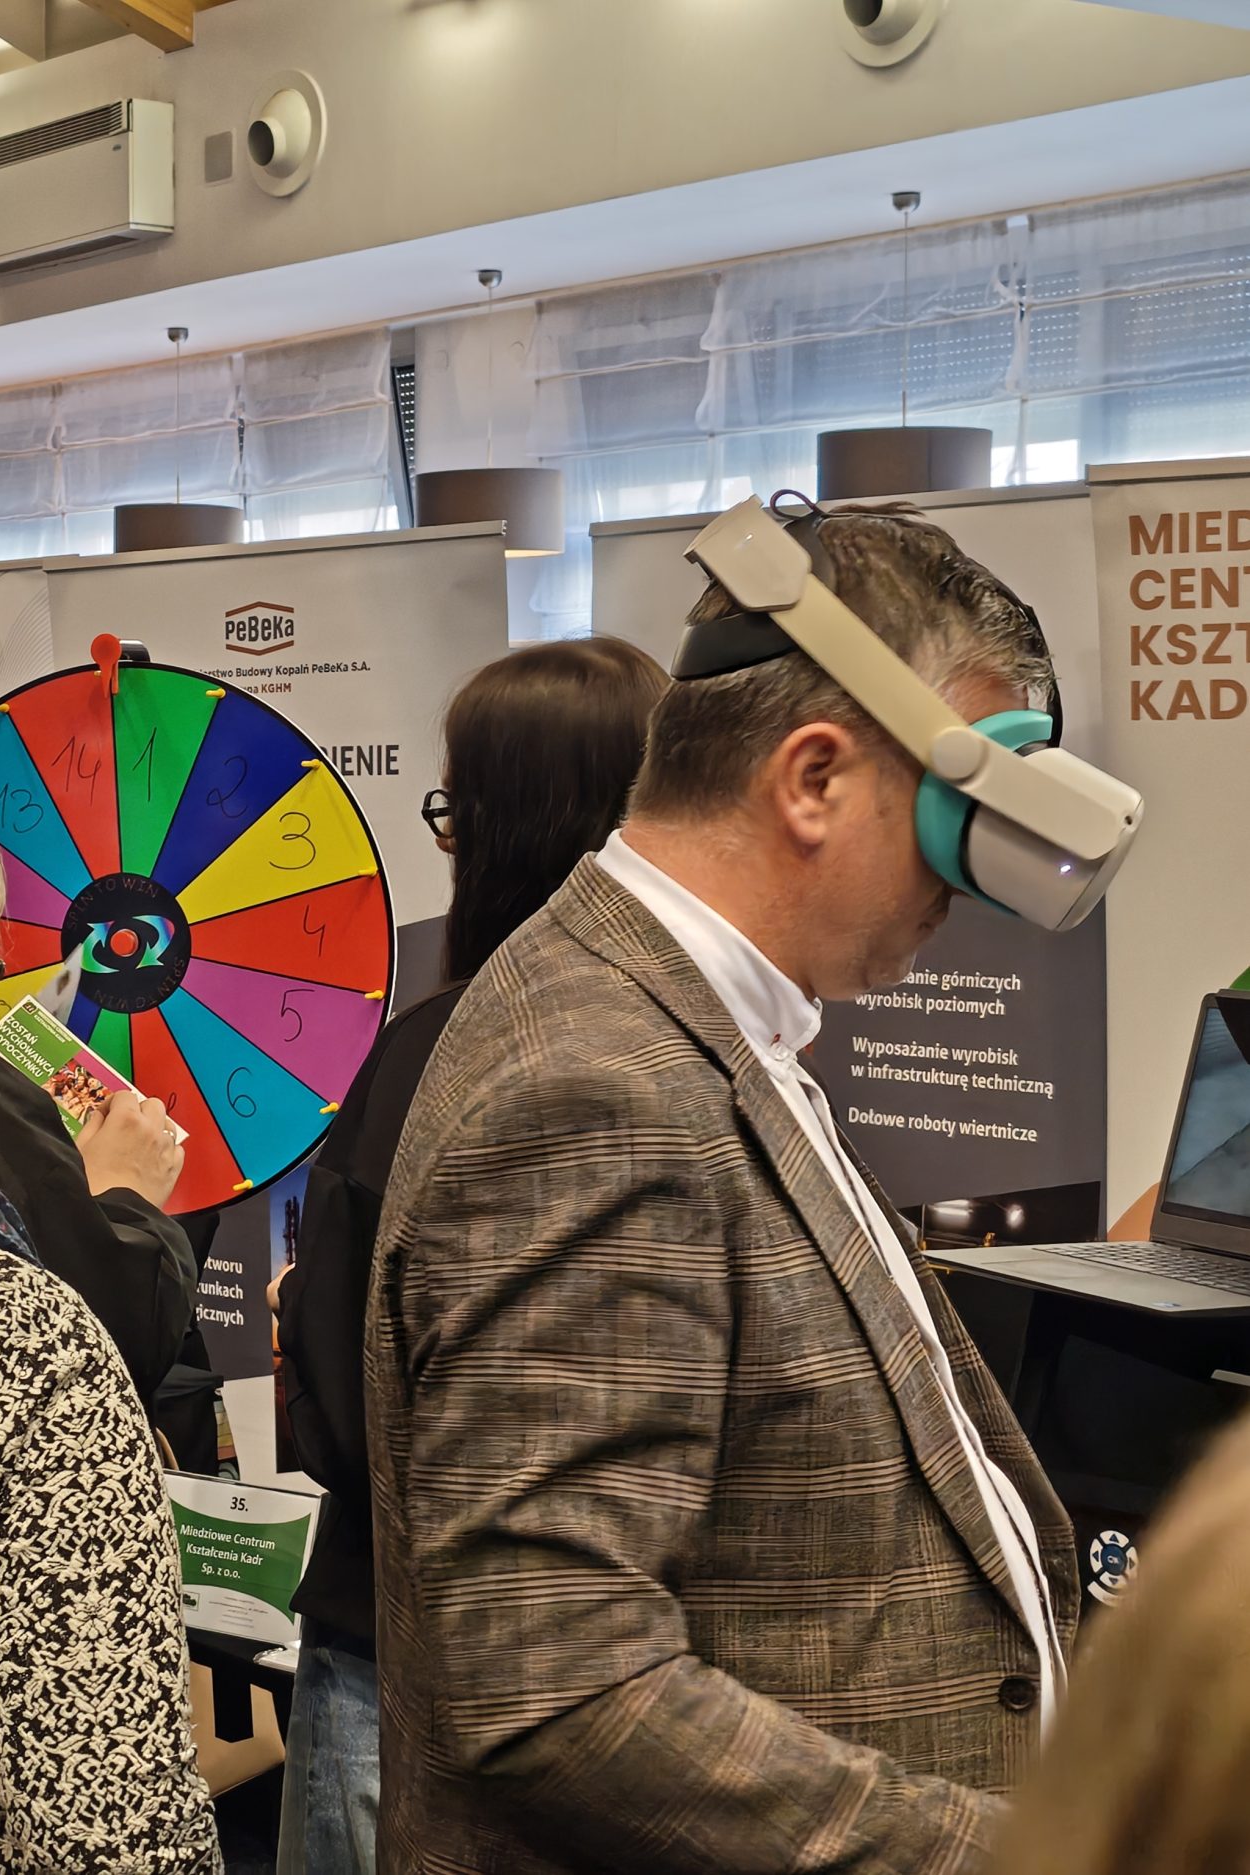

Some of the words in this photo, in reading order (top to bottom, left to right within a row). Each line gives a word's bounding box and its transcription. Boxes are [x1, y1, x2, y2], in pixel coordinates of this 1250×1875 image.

[1130, 566, 1250, 611] CEN
[225, 615, 295, 642] PeBeKa
[236, 667, 273, 678] Budowy
[275, 663, 310, 676] Kopalń
[312, 662, 349, 674] PeBeKa
[351, 661, 371, 672] S.A.
[261, 682, 292, 694] KGHM
[51, 736, 101, 806] 14
[132, 727, 157, 803] 1
[206, 755, 248, 818] 2
[269, 811, 316, 870] 3
[123, 878, 159, 898] WIN
[302, 904, 326, 957] 4
[902, 968, 939, 986] anie
[941, 971, 1021, 994] górniczych
[281, 988, 316, 1042] 5
[854, 991, 923, 1011] wyrobisk
[926, 995, 1006, 1018] poziomych
[5, 1015, 38, 1045] ZOSTAŃ
[0, 1021, 56, 1077] WYCHOWAWCĄ
[852, 1036, 949, 1060] Wyposażanie
[952, 1047, 1019, 1066] wyrobisk
[226, 1066, 257, 1118] 6
[851, 1063, 865, 1077] w
[867, 1061, 969, 1091] infrastrukturę
[971, 1072, 1055, 1099] techniczną
[848, 1106, 905, 1128] Dołowe
[908, 1114, 956, 1137] roboty
[959, 1119, 1038, 1142] wiertnicze
[230, 1496, 249, 1512] 35.
[180, 1524, 232, 1543] Miedziowe
[233, 1533, 276, 1550] Centrum
[186, 1543, 238, 1562] Kształcenia
[240, 1551, 264, 1566] Kadr
[201, 1562, 215, 1576] Sp.
[216, 1567, 223, 1576] z
[224, 1568, 241, 1579] o.o.
